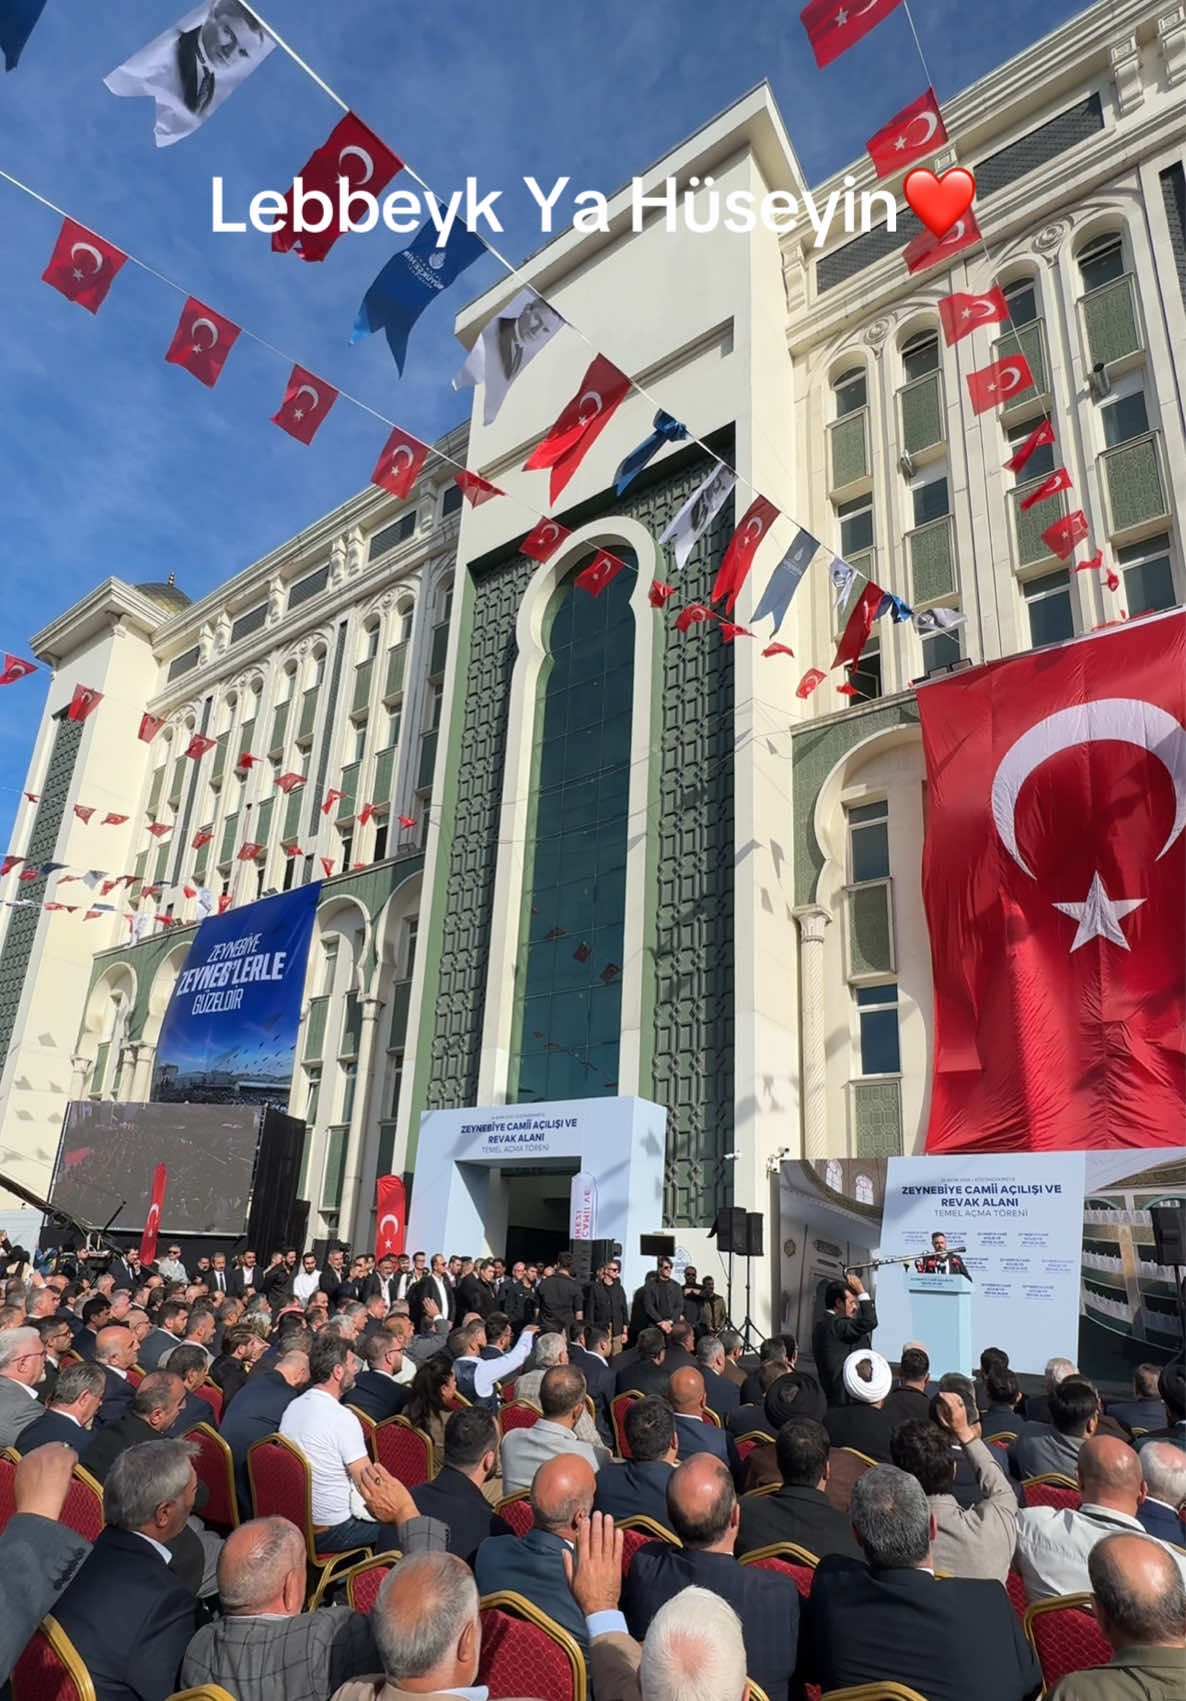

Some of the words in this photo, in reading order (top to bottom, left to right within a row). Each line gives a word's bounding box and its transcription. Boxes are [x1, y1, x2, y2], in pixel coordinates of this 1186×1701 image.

[207, 933, 263, 963] ZEYNEBİYE
[192, 985, 244, 1015] GÜZELDİR
[460, 1121, 505, 1134] ZEYNEBİYE
[506, 1119, 532, 1131] CAMİİ
[532, 1120, 564, 1131] AÇILIŞI
[565, 1118, 578, 1128] VE
[488, 1135, 517, 1144] REVAK
[517, 1133, 545, 1142] ALANI
[901, 1184, 963, 1196] ZEYNEBİYE
[964, 1183, 999, 1195] CAMİİ
[1000, 1184, 1043, 1196] AÇILIŞI
[1045, 1184, 1062, 1194] VE
[941, 1198, 980, 1207] REVAK
[982, 1198, 1019, 1207] ALANI
[934, 1209, 963, 1217] TEMEL
[964, 1209, 992, 1218] AÇMA
[994, 1207, 1028, 1217] TÖRENİ
